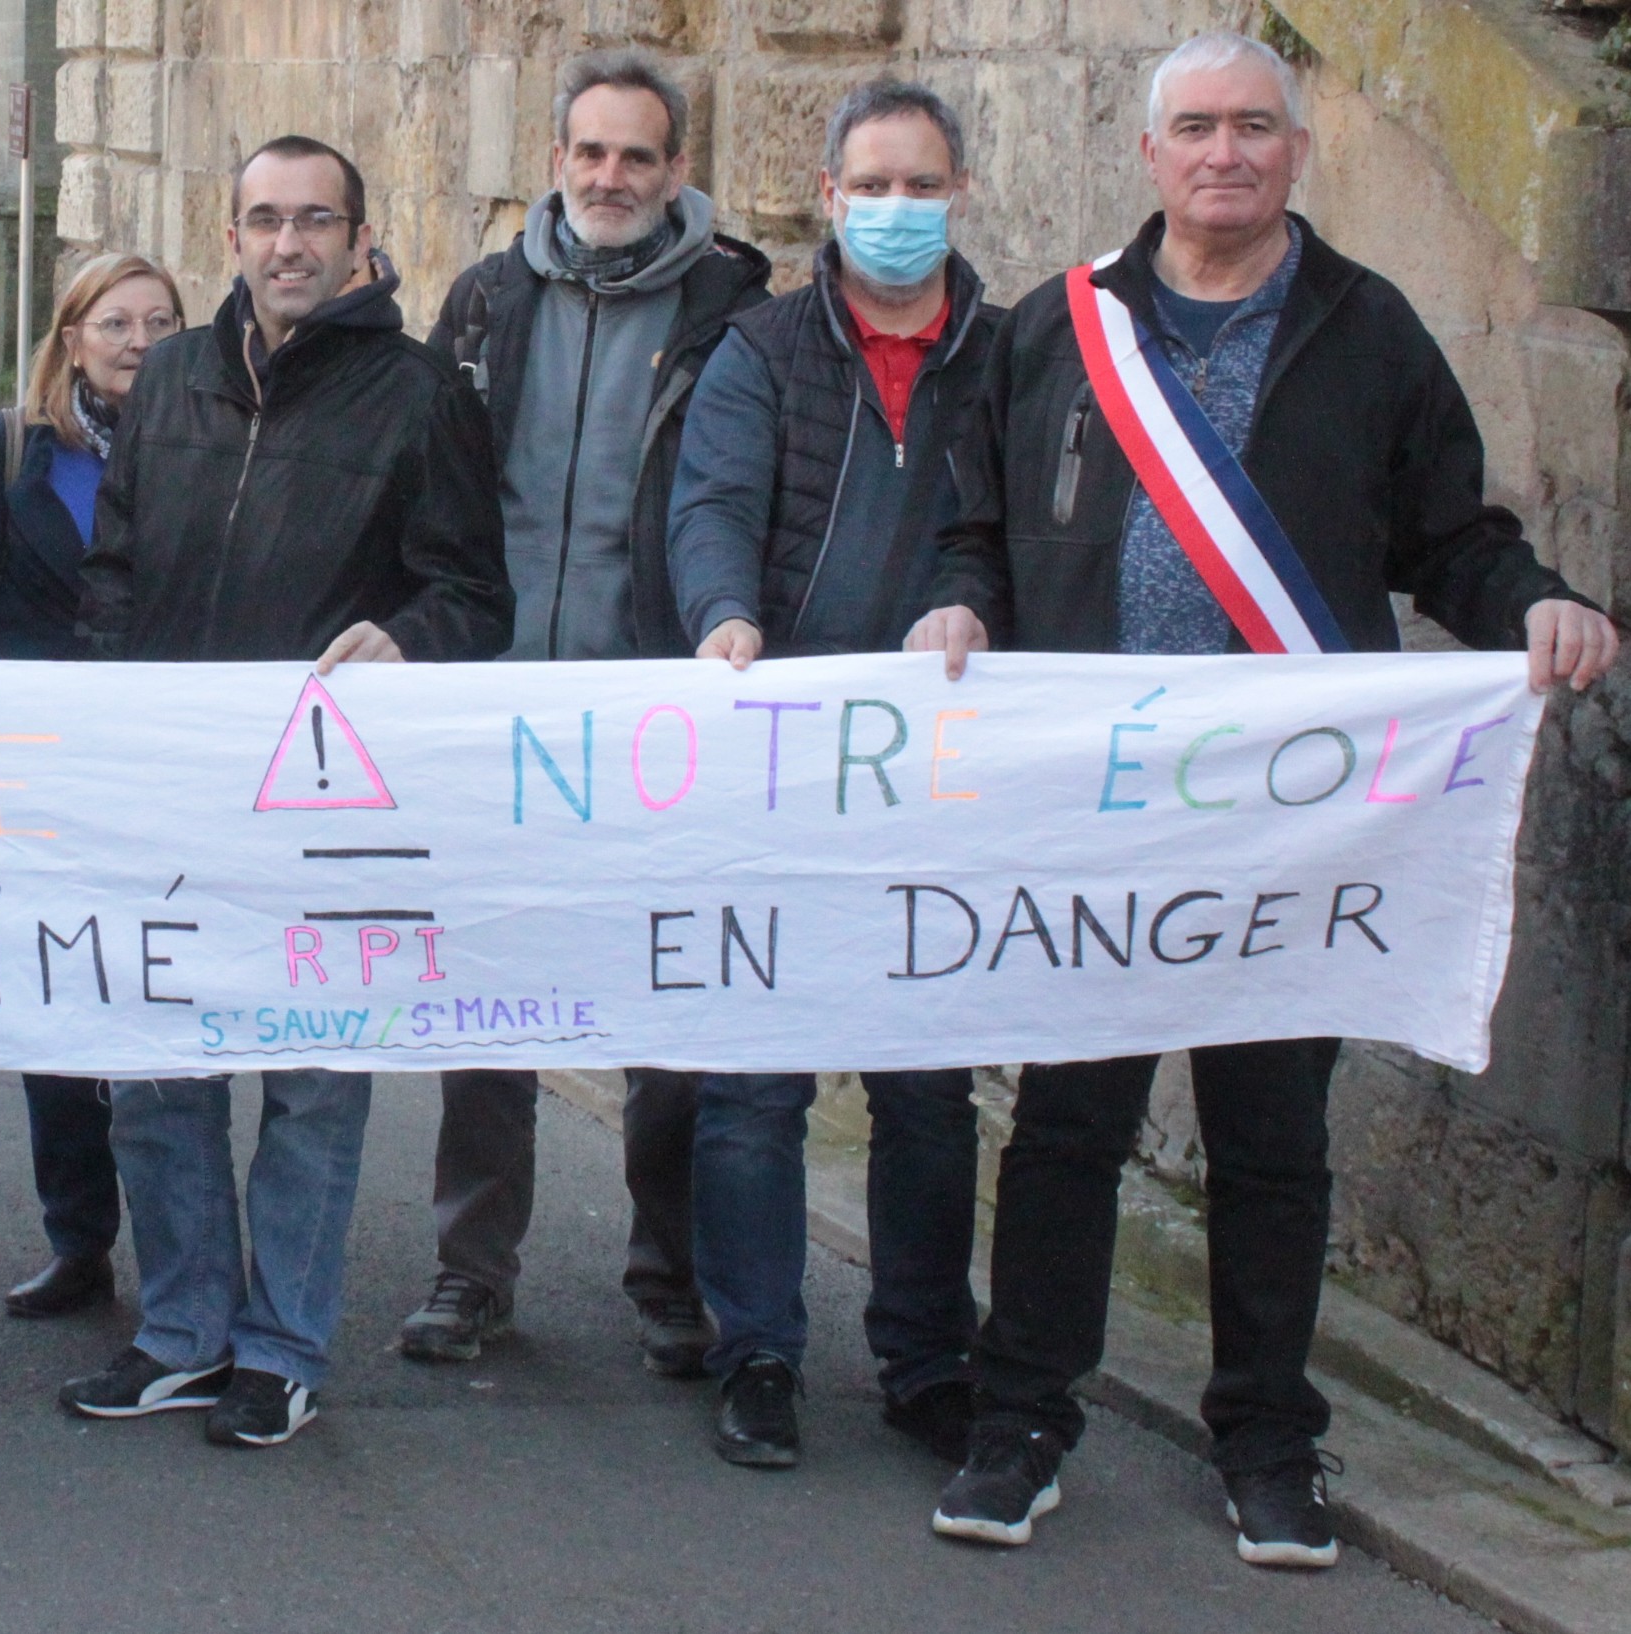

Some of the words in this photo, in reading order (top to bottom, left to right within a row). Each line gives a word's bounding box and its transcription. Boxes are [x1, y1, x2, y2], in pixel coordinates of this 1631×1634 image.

[512, 699, 980, 824] NOTRE
[1097, 686, 1514, 813] ÉCOLE
[650, 906, 779, 991] EN
[886, 882, 1391, 979] DANGER
